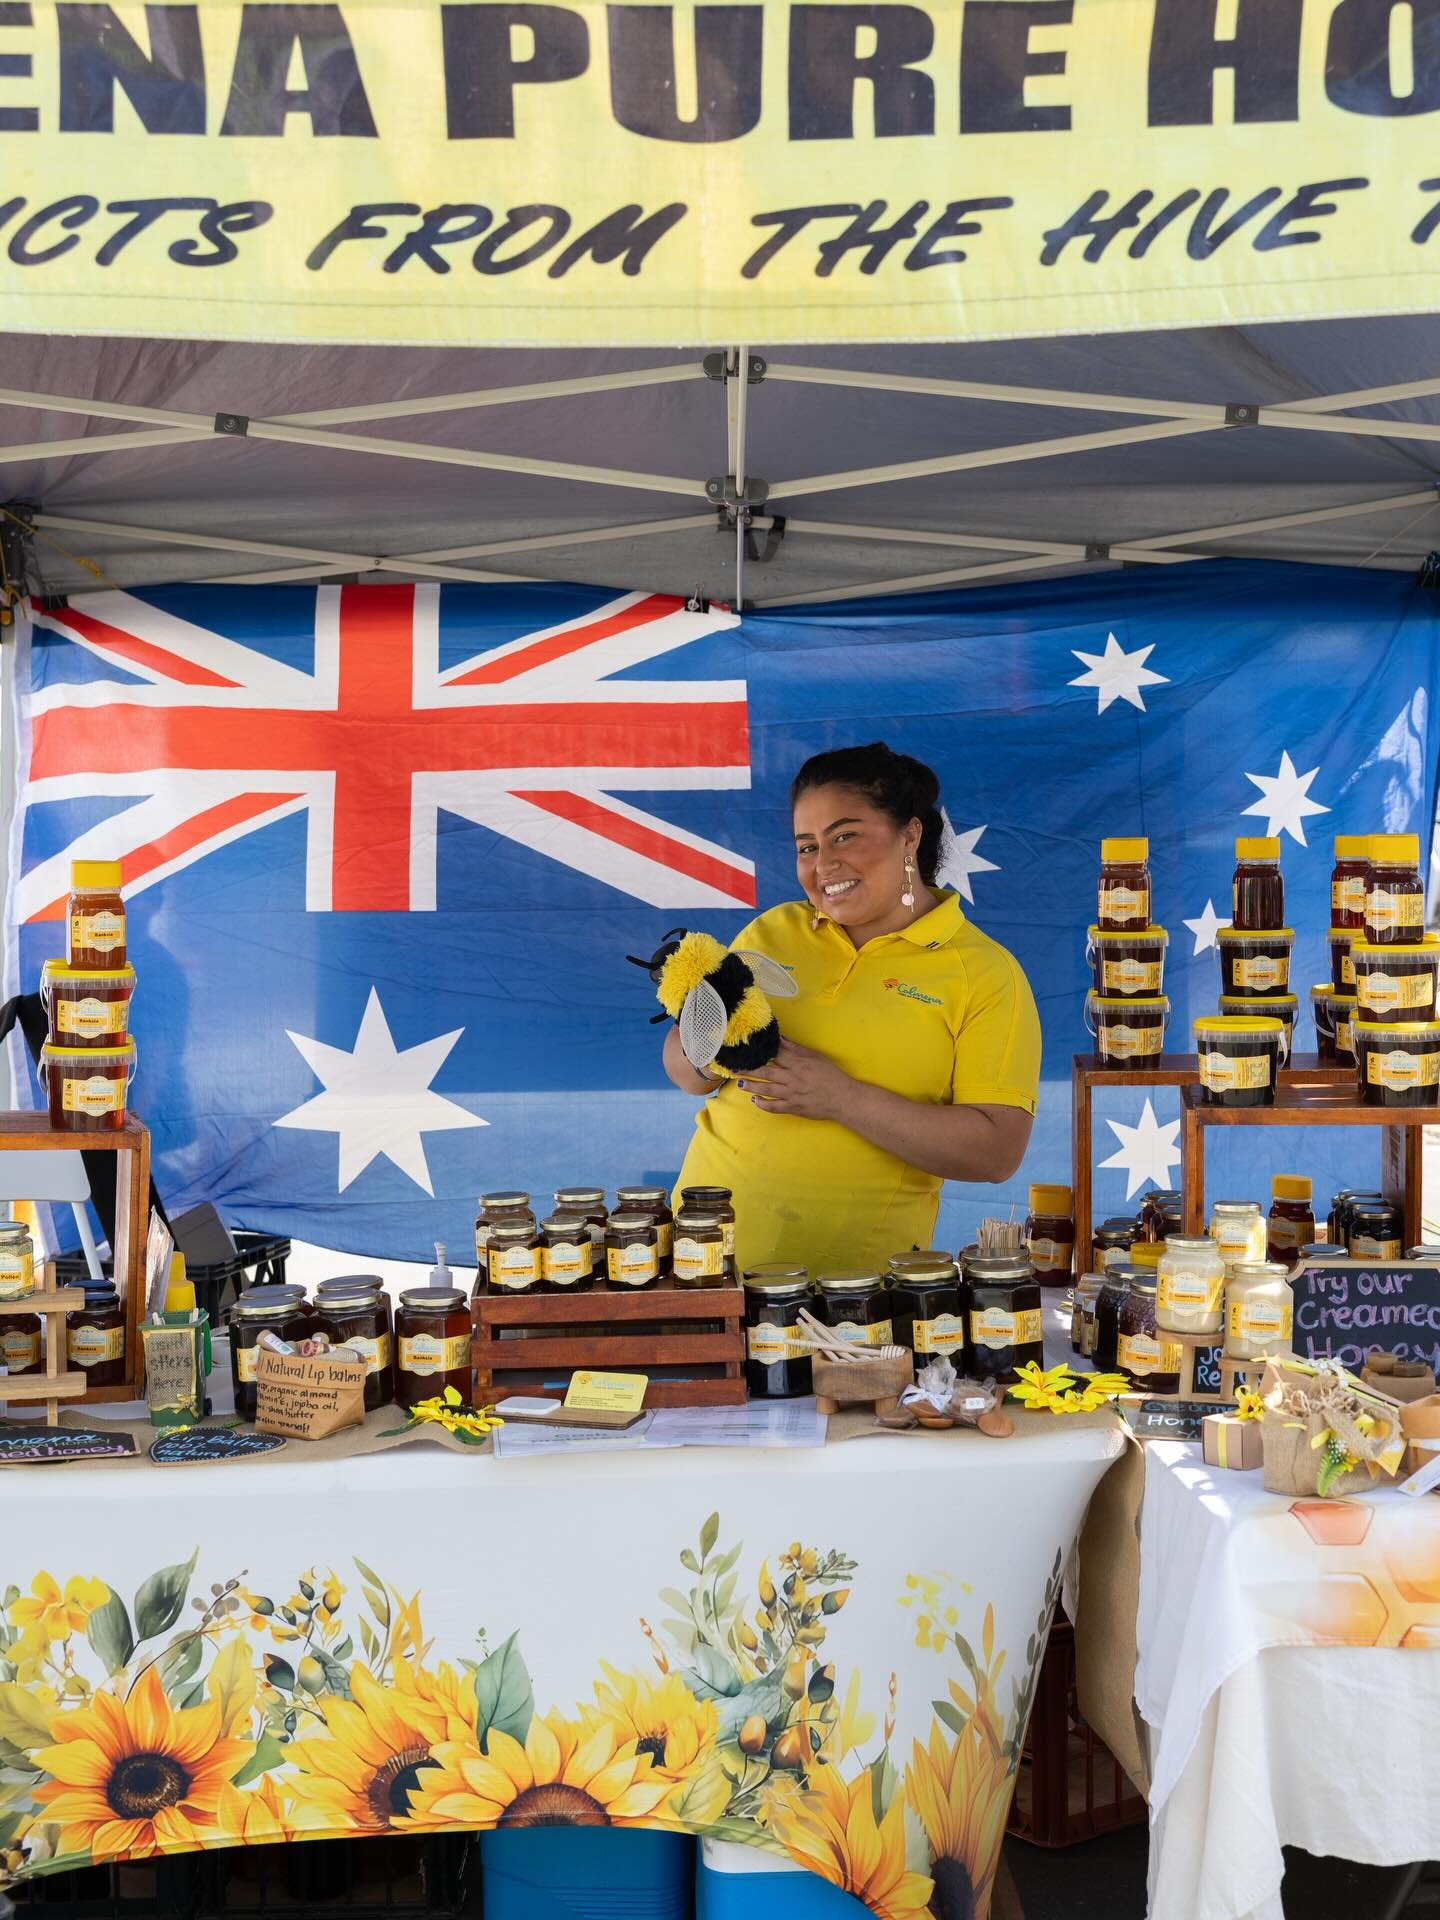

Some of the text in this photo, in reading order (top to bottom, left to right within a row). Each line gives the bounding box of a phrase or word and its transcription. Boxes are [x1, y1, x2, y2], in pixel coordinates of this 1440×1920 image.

[441, 1, 1073, 143] PURE
[306, 203, 688, 278] FROM
[741, 197, 1014, 278] THE
[1039, 177, 1369, 266] HIVE
[1303, 1269, 1413, 1304] Try our
[266, 1358, 305, 1379] Natural
[308, 1363, 325, 1385] Lip
[329, 1365, 361, 1382] balms
[300, 1388, 338, 1400] almond
[47, 1444, 124, 1456] honey
